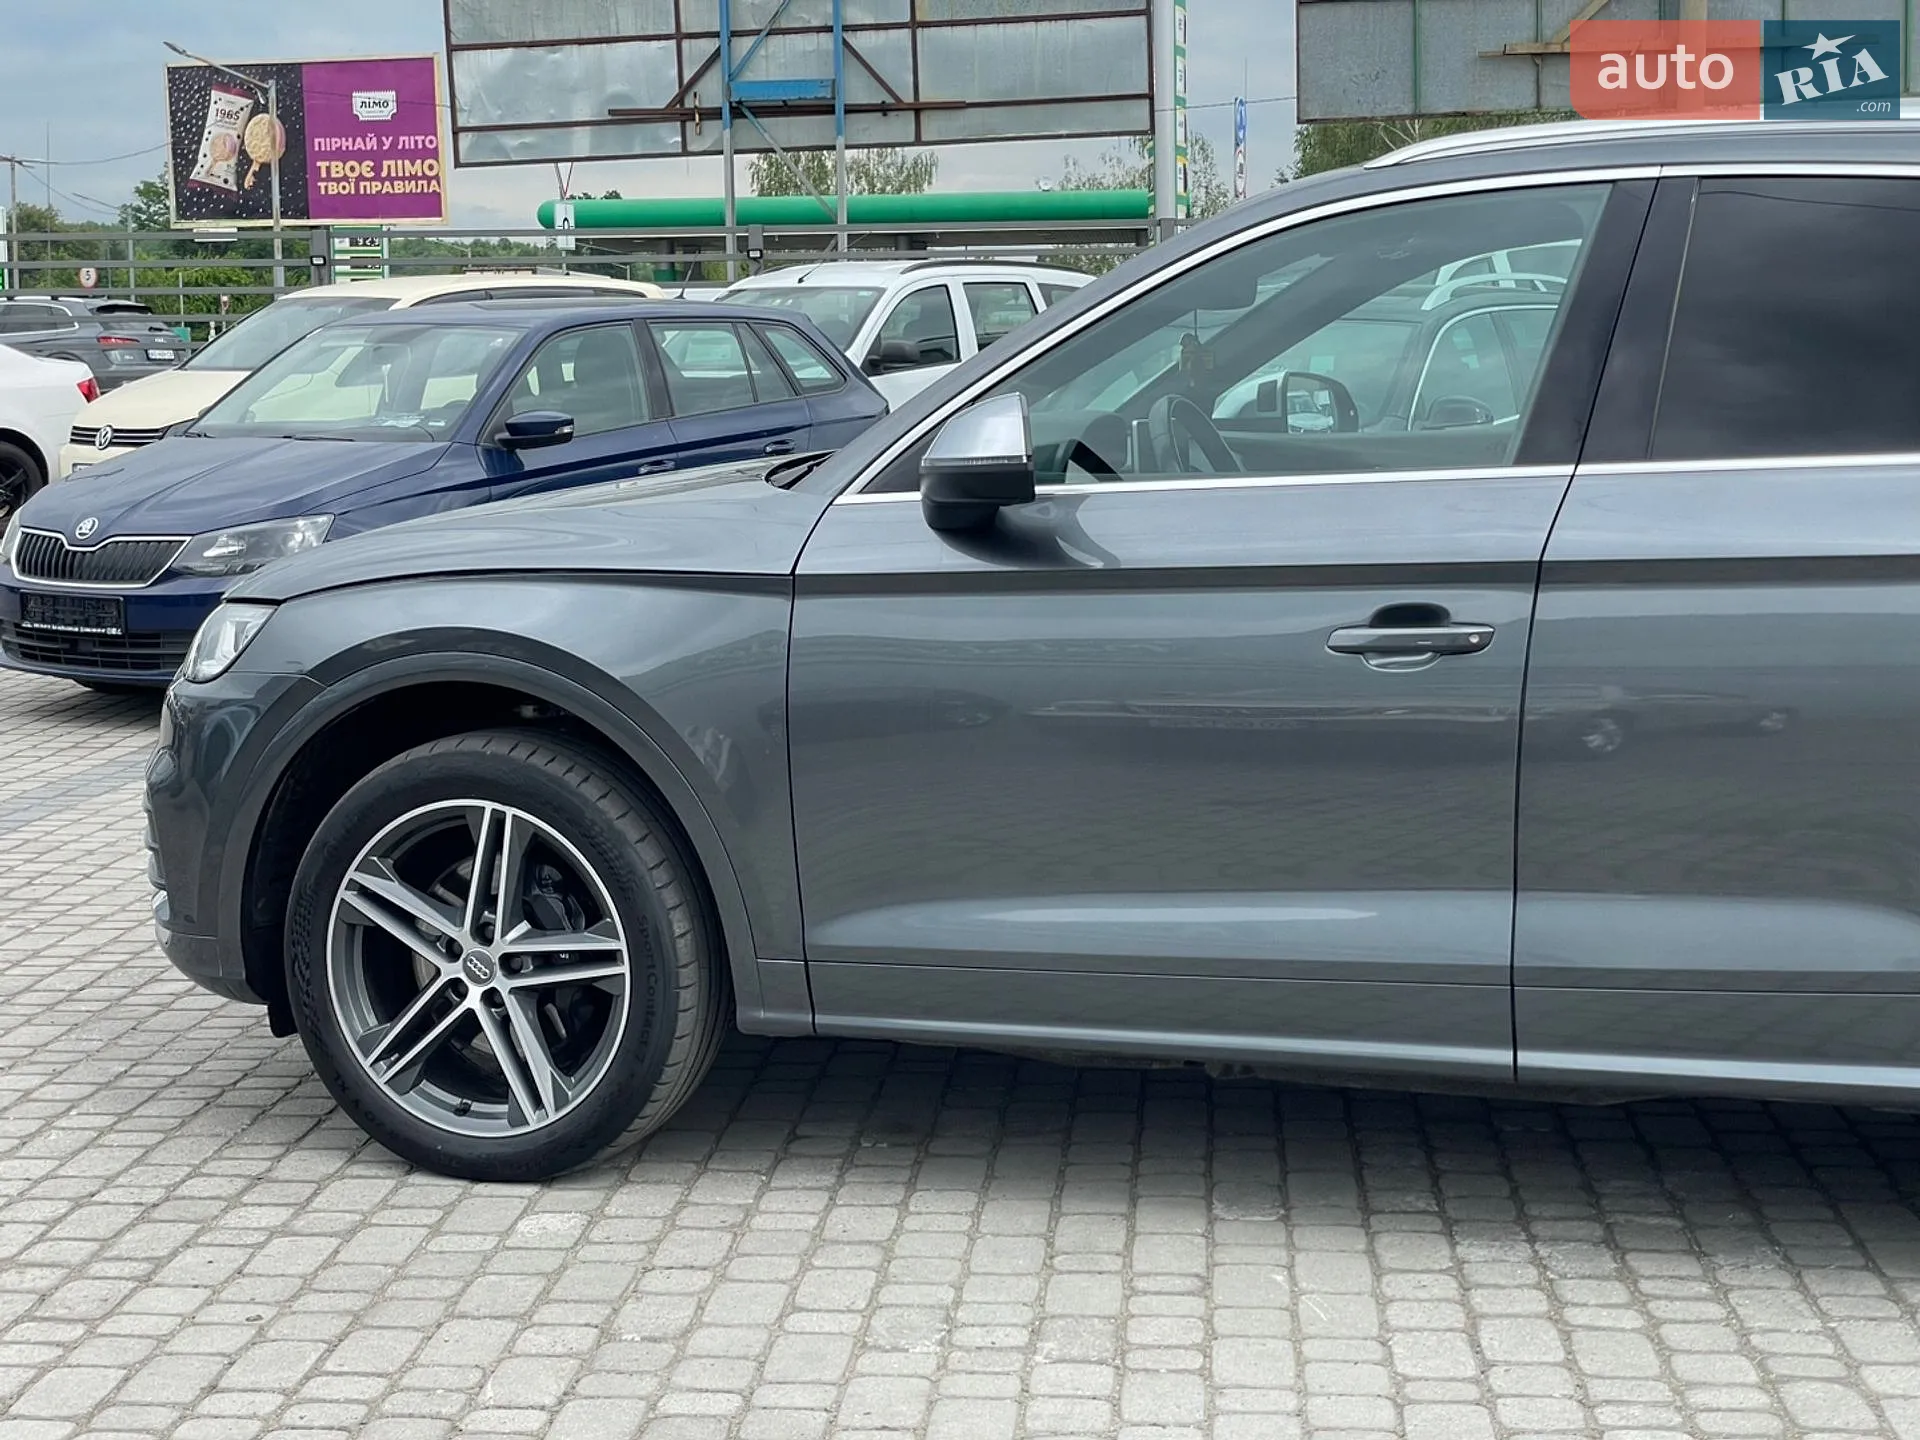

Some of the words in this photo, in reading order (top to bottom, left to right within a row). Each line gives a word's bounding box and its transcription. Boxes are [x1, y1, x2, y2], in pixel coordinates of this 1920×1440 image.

[215, 108, 240, 121] 1965
[314, 133, 378, 151] ПІРНАЙ
[381, 136, 393, 148] У
[397, 135, 437, 150] ЛІТО
[316, 160, 375, 178] ТВОЄ
[381, 159, 440, 177] ЛІМО
[317, 178, 355, 195] ТВОЇ
[359, 179, 441, 195] ПРАВИЛА
